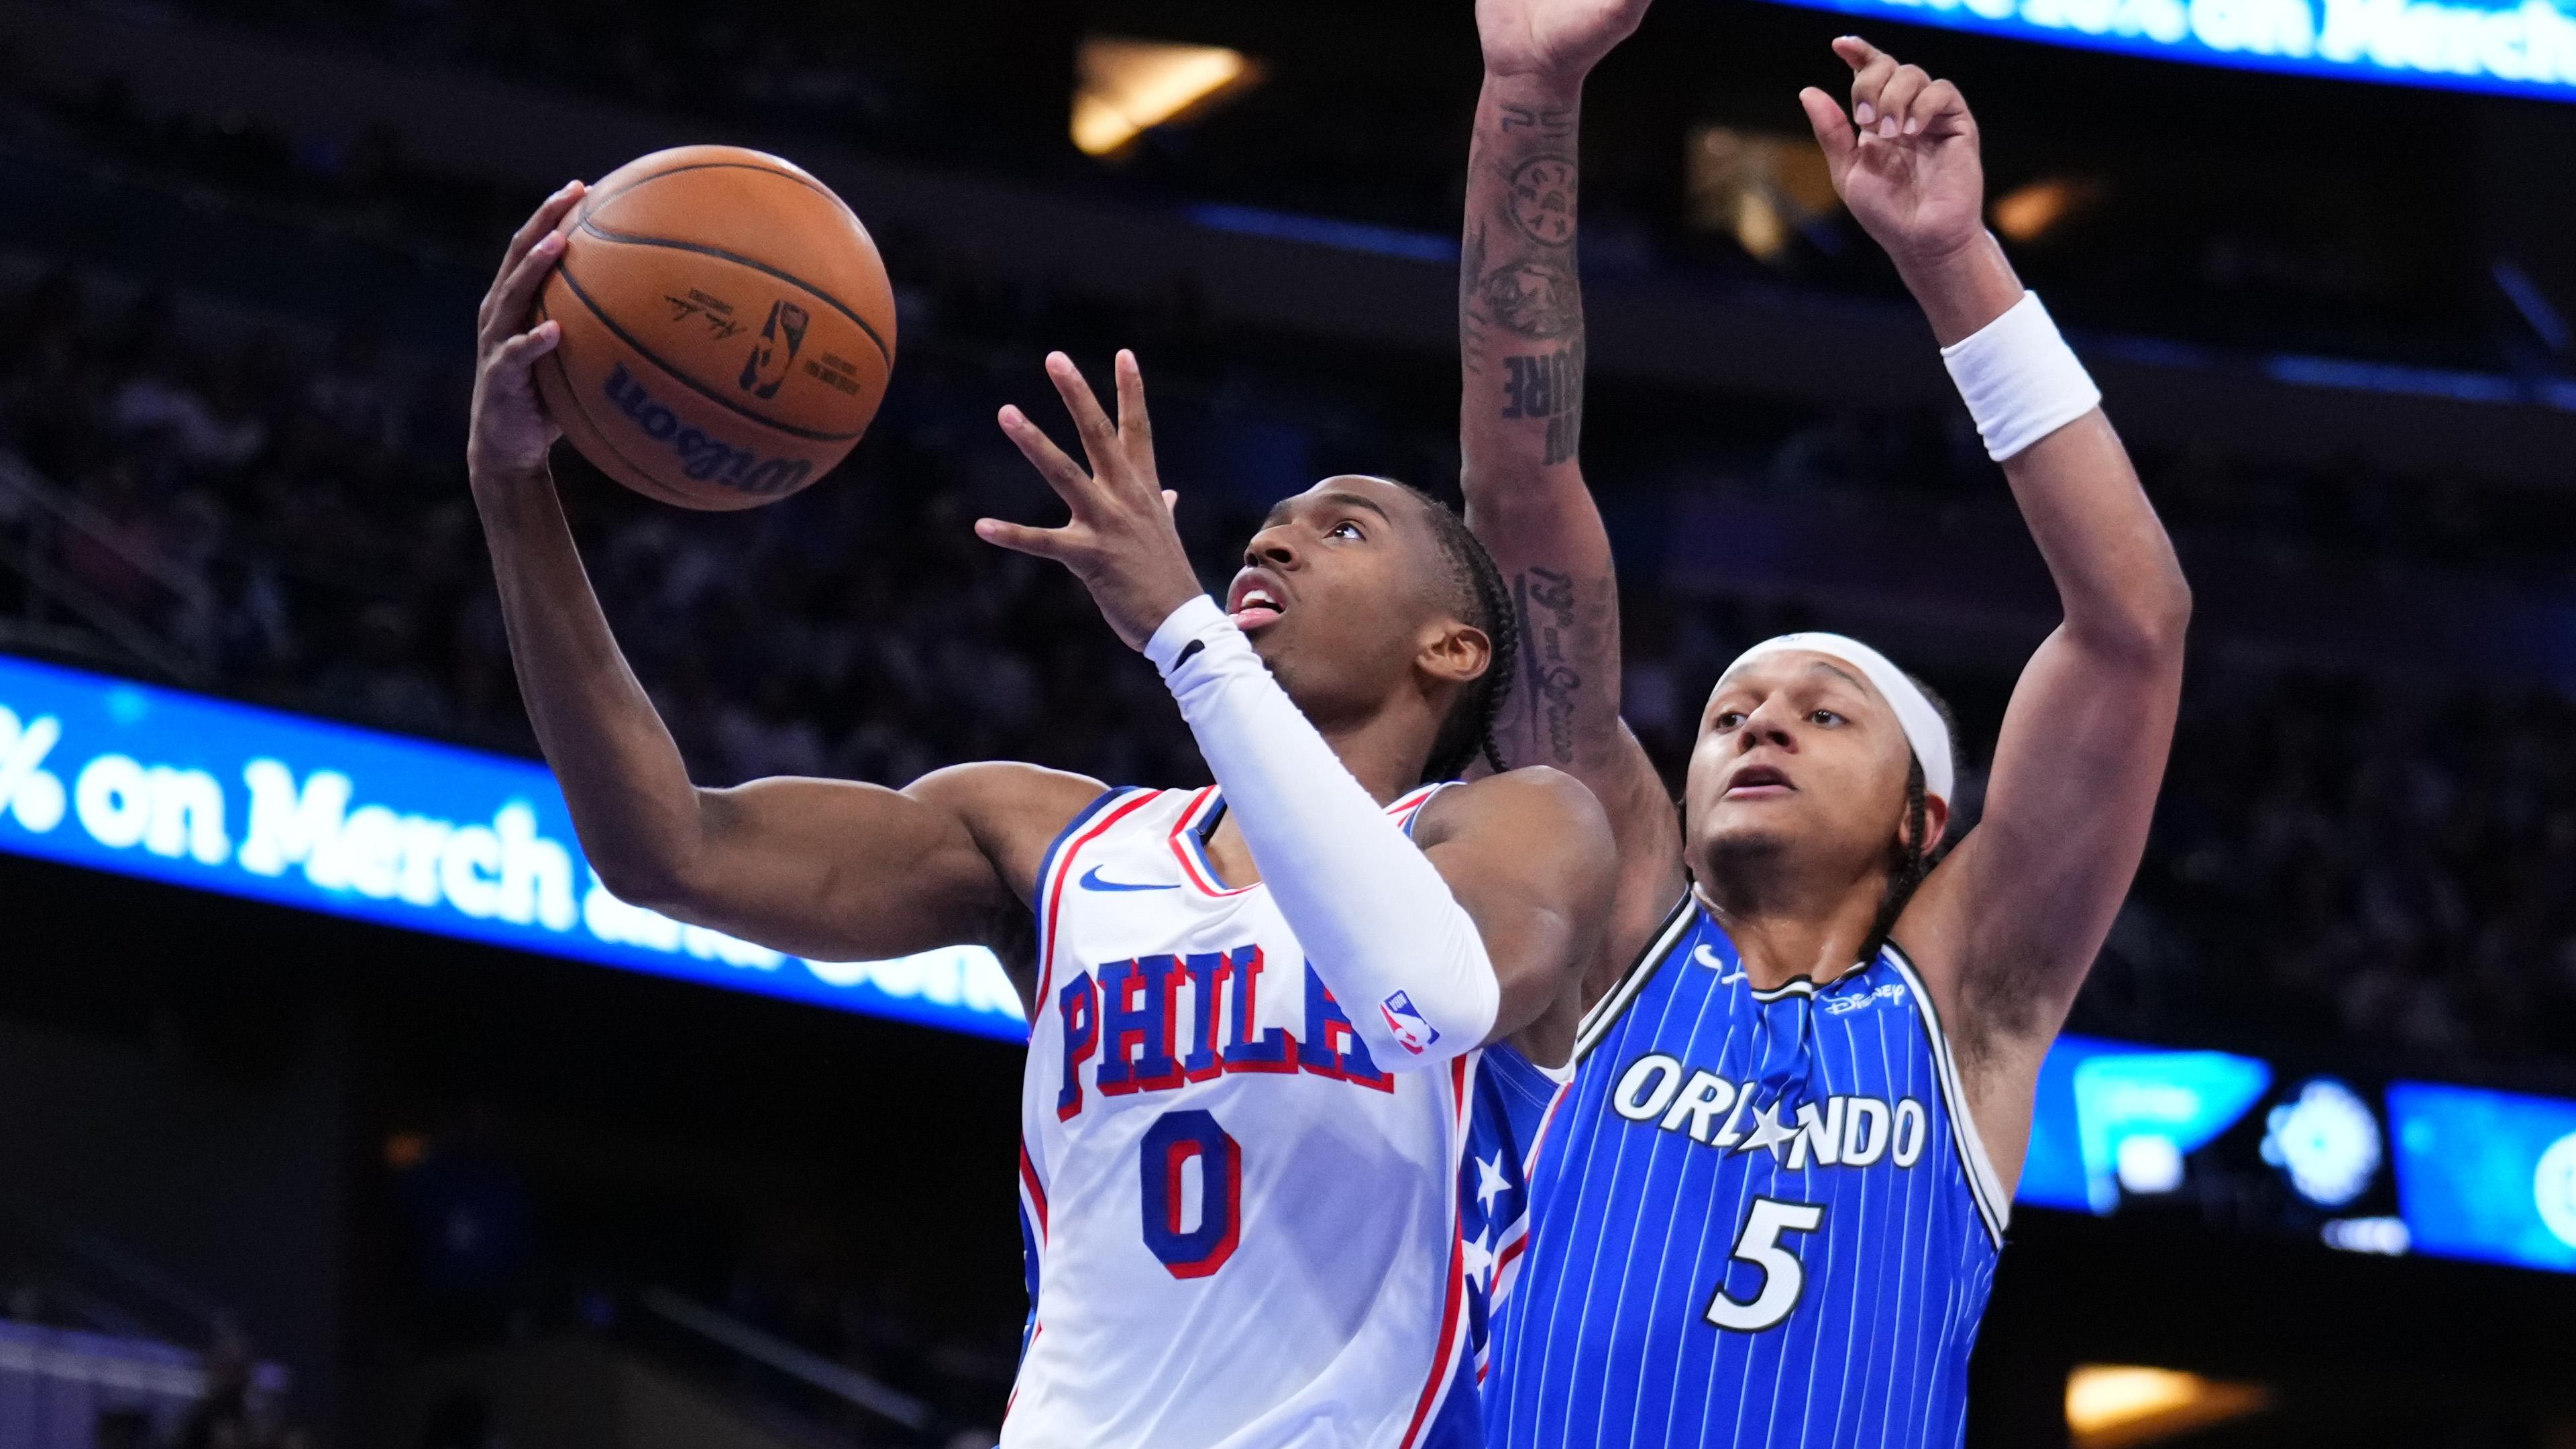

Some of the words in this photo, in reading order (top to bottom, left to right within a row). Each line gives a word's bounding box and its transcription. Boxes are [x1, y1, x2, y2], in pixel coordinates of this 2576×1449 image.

[74, 752, 231, 865] on
[238, 757, 580, 932] Merch
[1389, 992, 1407, 1012] NBA
[1820, 983, 1905, 1016] Disney
[1140, 1110, 1241, 1280] 0
[1703, 1195, 1827, 1334] 5
